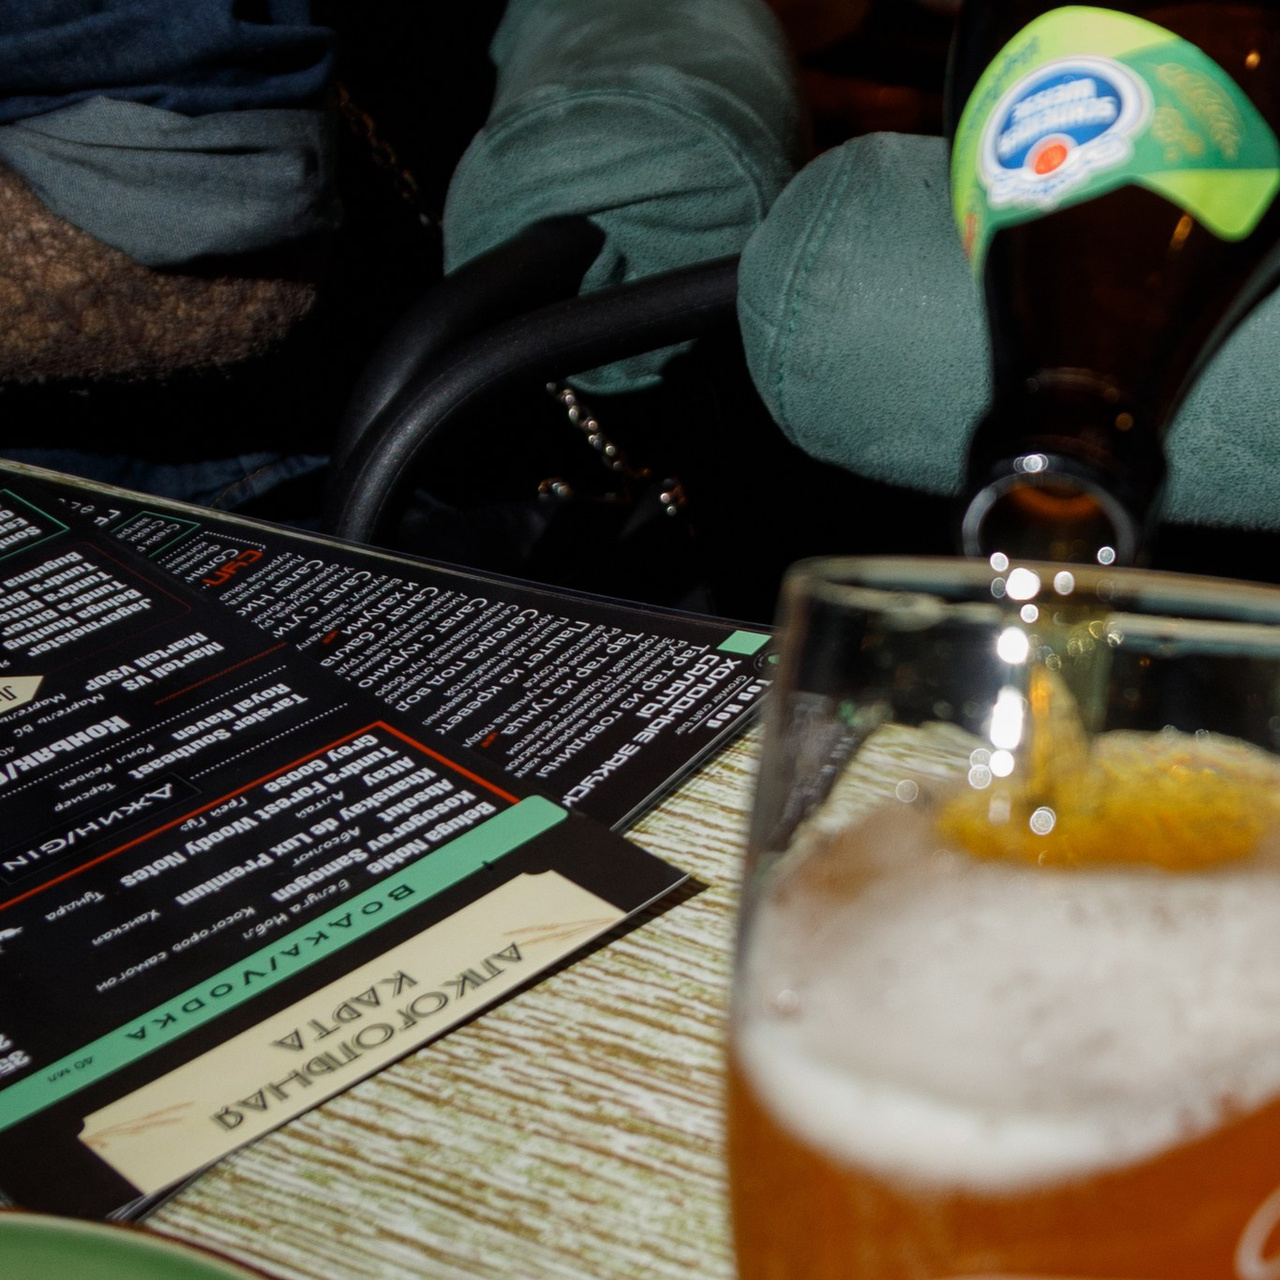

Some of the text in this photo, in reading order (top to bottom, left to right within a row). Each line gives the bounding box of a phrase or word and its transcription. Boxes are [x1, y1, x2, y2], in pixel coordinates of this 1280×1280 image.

[3, 551, 83, 587] Bugulma
[28, 562, 98, 592] Tundra
[42, 571, 112, 602] Tundra
[184, 549, 239, 583] Солян
[271, 560, 323, 593] Салат
[319, 571, 371, 605] Салат
[57, 580, 127, 611] Tundra
[341, 582, 418, 634] и халуми
[386, 587, 438, 621] Салат
[435, 598, 487, 633] Салат
[2, 589, 142, 650] Beluga Hunting
[27, 598, 151, 656] Jagermeister
[272, 613, 307, 638] ути
[371, 622, 386, 630] с
[420, 634, 435, 642] с
[462, 609, 538, 659] Селедка
[527, 617, 569, 647] Паштет
[85, 632, 208, 691] Martell VSOP
[121, 641, 224, 691] Martell VS
[334, 655, 365, 676] груд
[513, 647, 528, 656] из
[522, 624, 606, 688] азиатском соусе
[523, 621, 590, 668] Паштет
[567, 627, 622, 666] Рубленое
[601, 637, 675, 693] Заправляется
[629, 640, 688, 684] Рубленная
[426, 661, 467, 685] под
[499, 669, 524, 684] из
[501, 632, 644, 734] Тар тар из тунца
[539, 666, 570, 687] филе
[636, 654, 720, 718] САЛАТЫ
[171, 683, 291, 740] Royal Raven
[492, 712, 510, 723] на
[507, 688, 542, 712] тунца
[536, 644, 710, 777] Тар тар из говядины
[632, 658, 742, 743] ХОЛОДНЫЕ
[675, 675, 747, 735] Growler craft bar
[706, 704, 743, 728] Hop
[128, 694, 308, 779] Tarsier Southeast
[506, 720, 553, 755] багетом
[263, 734, 378, 792] Grey Goose
[362, 756, 415, 786] Altay
[120, 746, 398, 887] Tundra Forest Woody Notes
[376, 778, 454, 822] Absolut
[175, 767, 437, 905] Khanskay de Lux Premium
[271, 790, 476, 902] Kosogorov Samogon
[366, 801, 496, 874] Beluga Noble
[272, 970, 418, 1052] КАРТА
[211, 942, 522, 1132] АЛКОГОЛЬНАЯ
